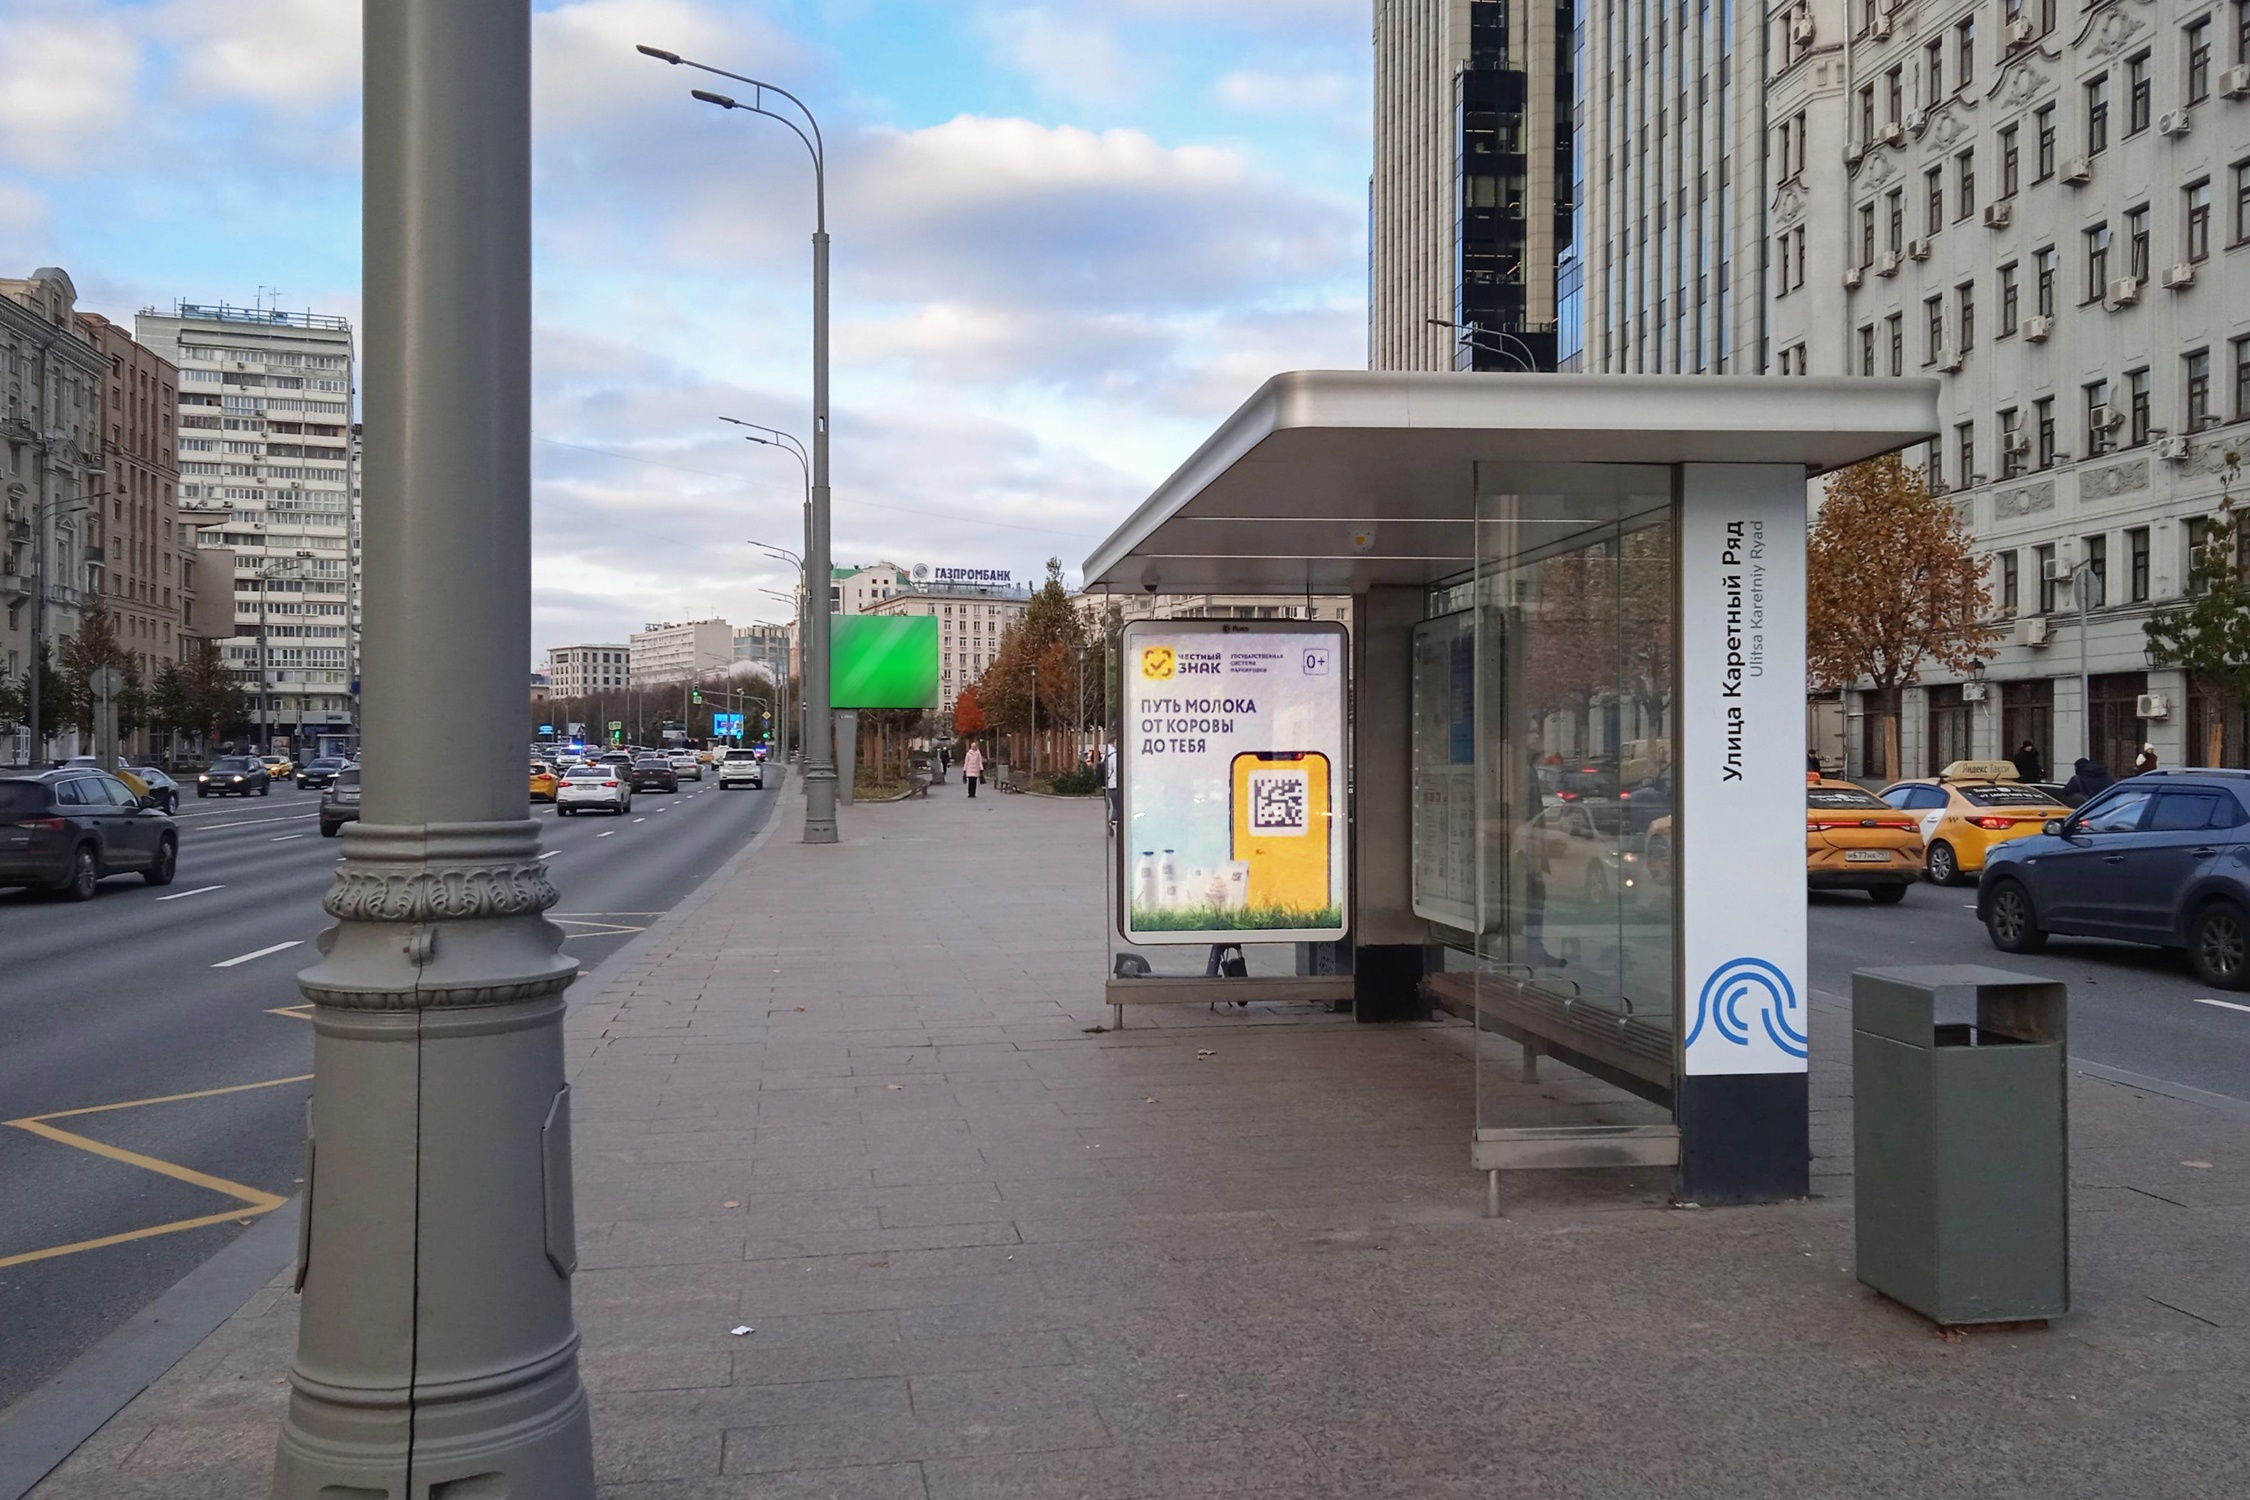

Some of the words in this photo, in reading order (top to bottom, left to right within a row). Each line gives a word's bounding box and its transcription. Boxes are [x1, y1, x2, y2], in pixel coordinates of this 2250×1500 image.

[1722, 521, 1744, 565] Ряд
[1750, 520, 1766, 559] Ryad
[935, 567, 1011, 581] ГАЗПРОМБАНК
[1750, 564, 1766, 629] Karetniy
[1722, 575, 1745, 698] Каретный
[1177, 652, 1222, 660] ЧЕСТНЫЙ
[1306, 655, 1326, 669] 0+
[1750, 633, 1763, 677] Ulitsa
[1178, 662, 1222, 674] ЗНАК
[1141, 699, 1182, 713] ПУТЬ
[1185, 699, 1257, 713] МОЛОКА
[1141, 719, 1163, 733] ОТ
[1167, 719, 1234, 733] КОРОВЫ
[1141, 739, 1166, 755] ДО
[1169, 739, 1206, 753] ТЕБЯ
[1722, 706, 1745, 782] Улица
[1962, 763, 1988, 774] Яндекс
[1990, 763, 2010, 773] Такси
